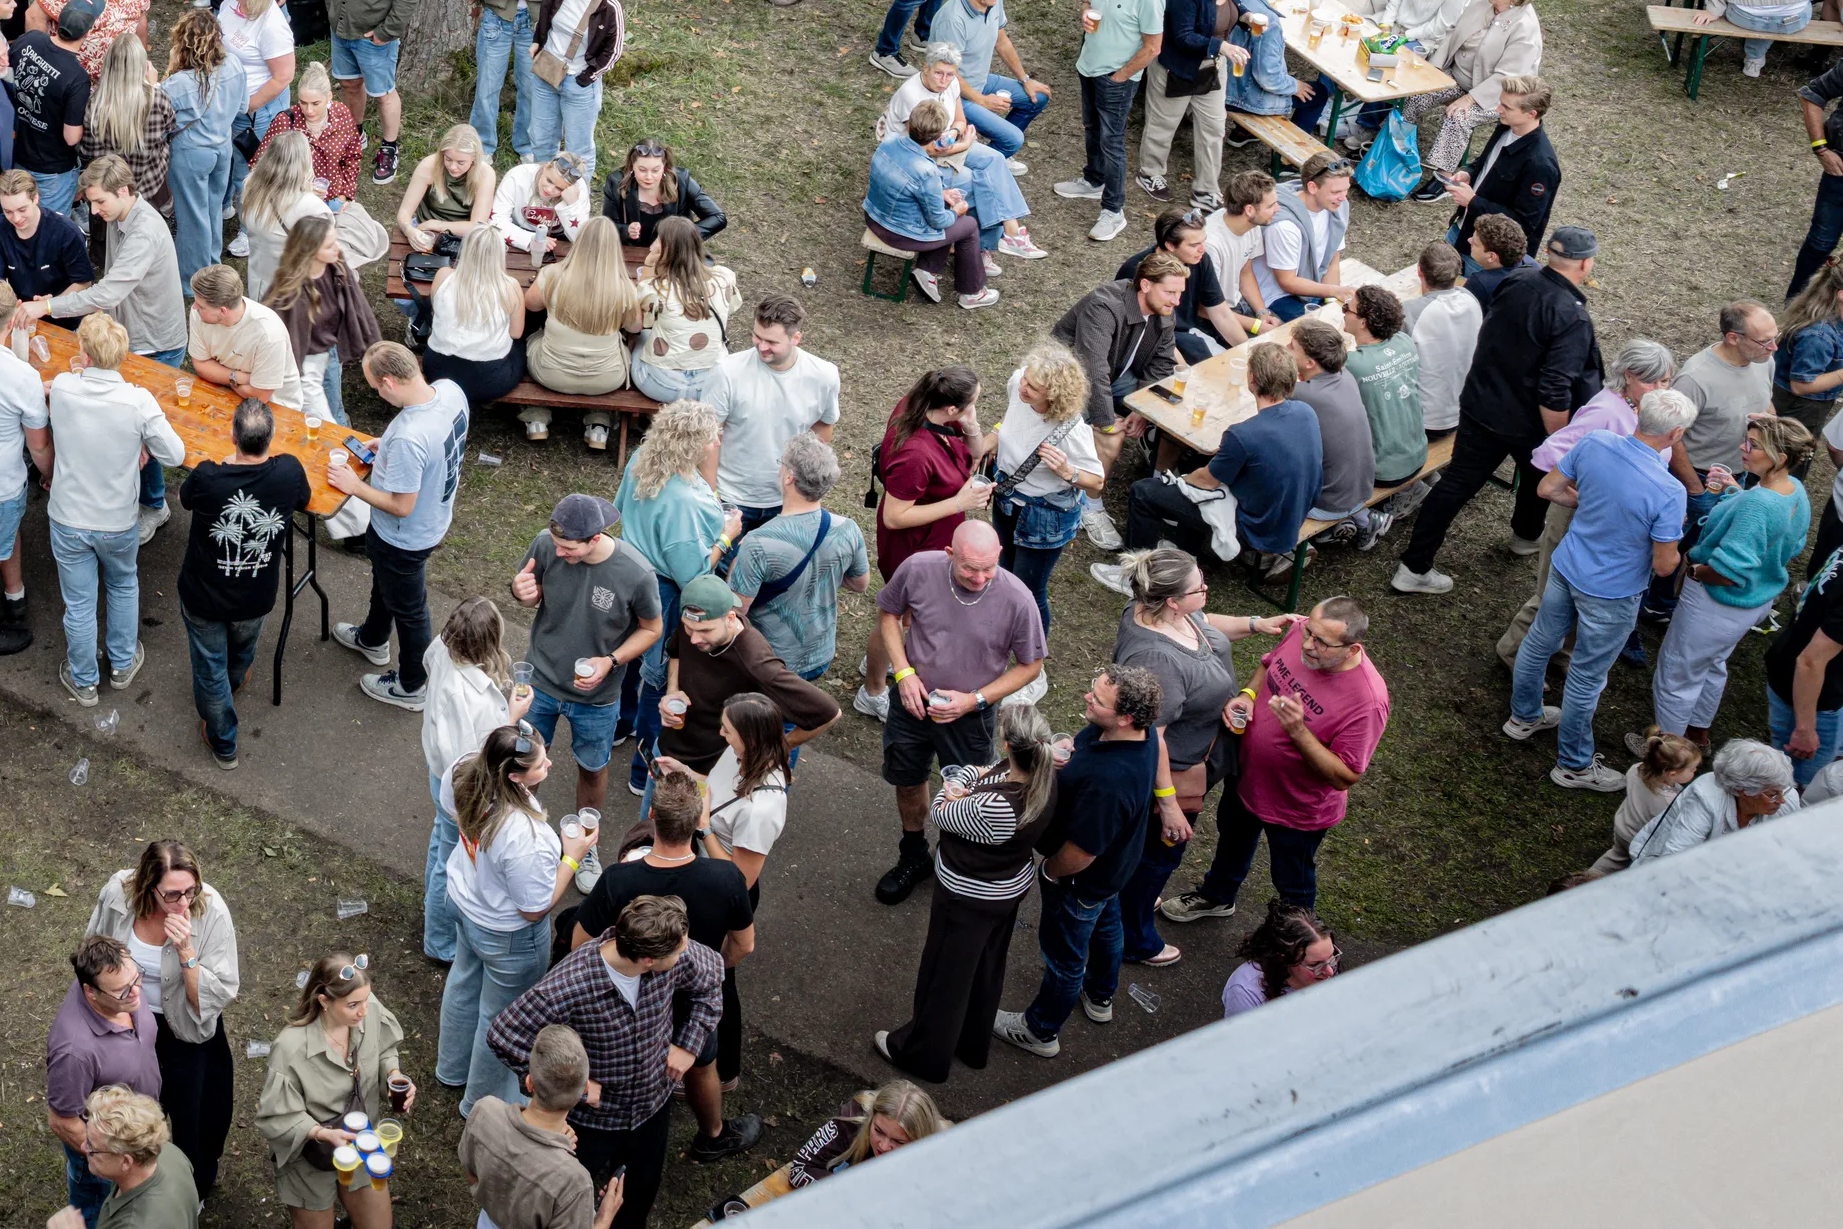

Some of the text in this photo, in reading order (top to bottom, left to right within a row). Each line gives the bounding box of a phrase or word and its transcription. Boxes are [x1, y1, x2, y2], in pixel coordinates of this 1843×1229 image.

[21, 45, 61, 79] SPAGHETTI
[1361, 367, 1396, 383] NOUVELLE
[1275, 658, 1324, 715] PME LEGEND
